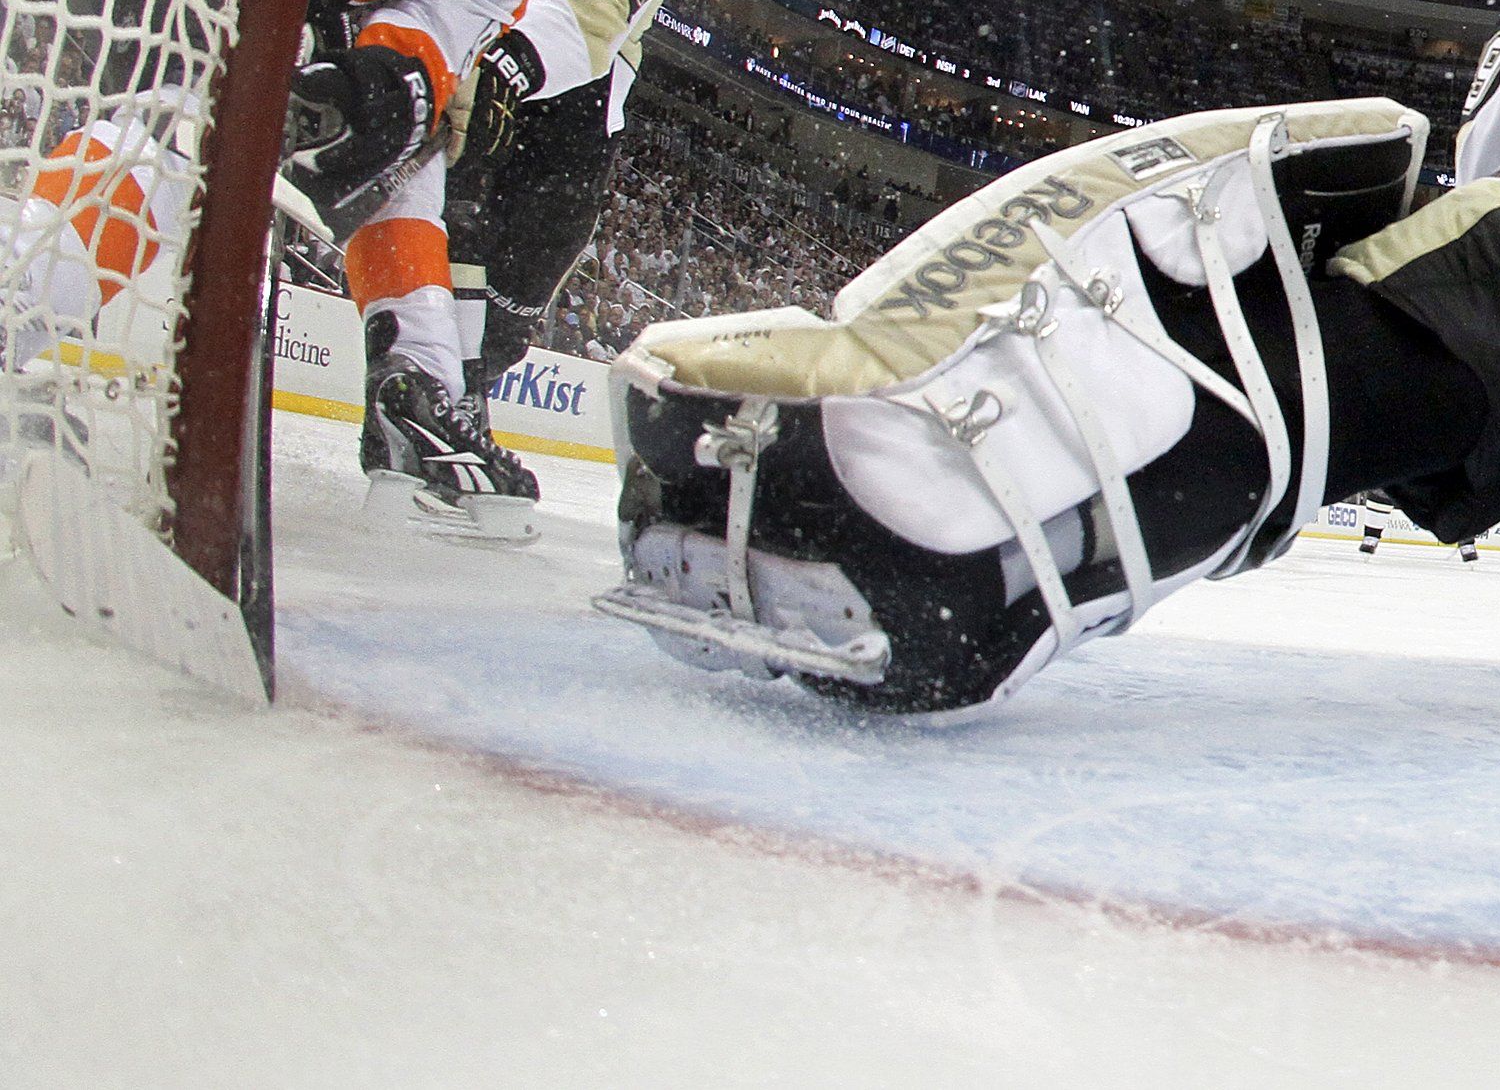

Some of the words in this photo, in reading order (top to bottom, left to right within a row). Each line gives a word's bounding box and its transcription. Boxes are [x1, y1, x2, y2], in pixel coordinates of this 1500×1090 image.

[899, 43, 916, 59] DET
[935, 59, 957, 75] NSH
[1028, 88, 1047, 102] LAK
[1070, 101, 1090, 116] VAN
[878, 174, 1095, 320] Reebok
[1328, 506, 1358, 528] GEICO
